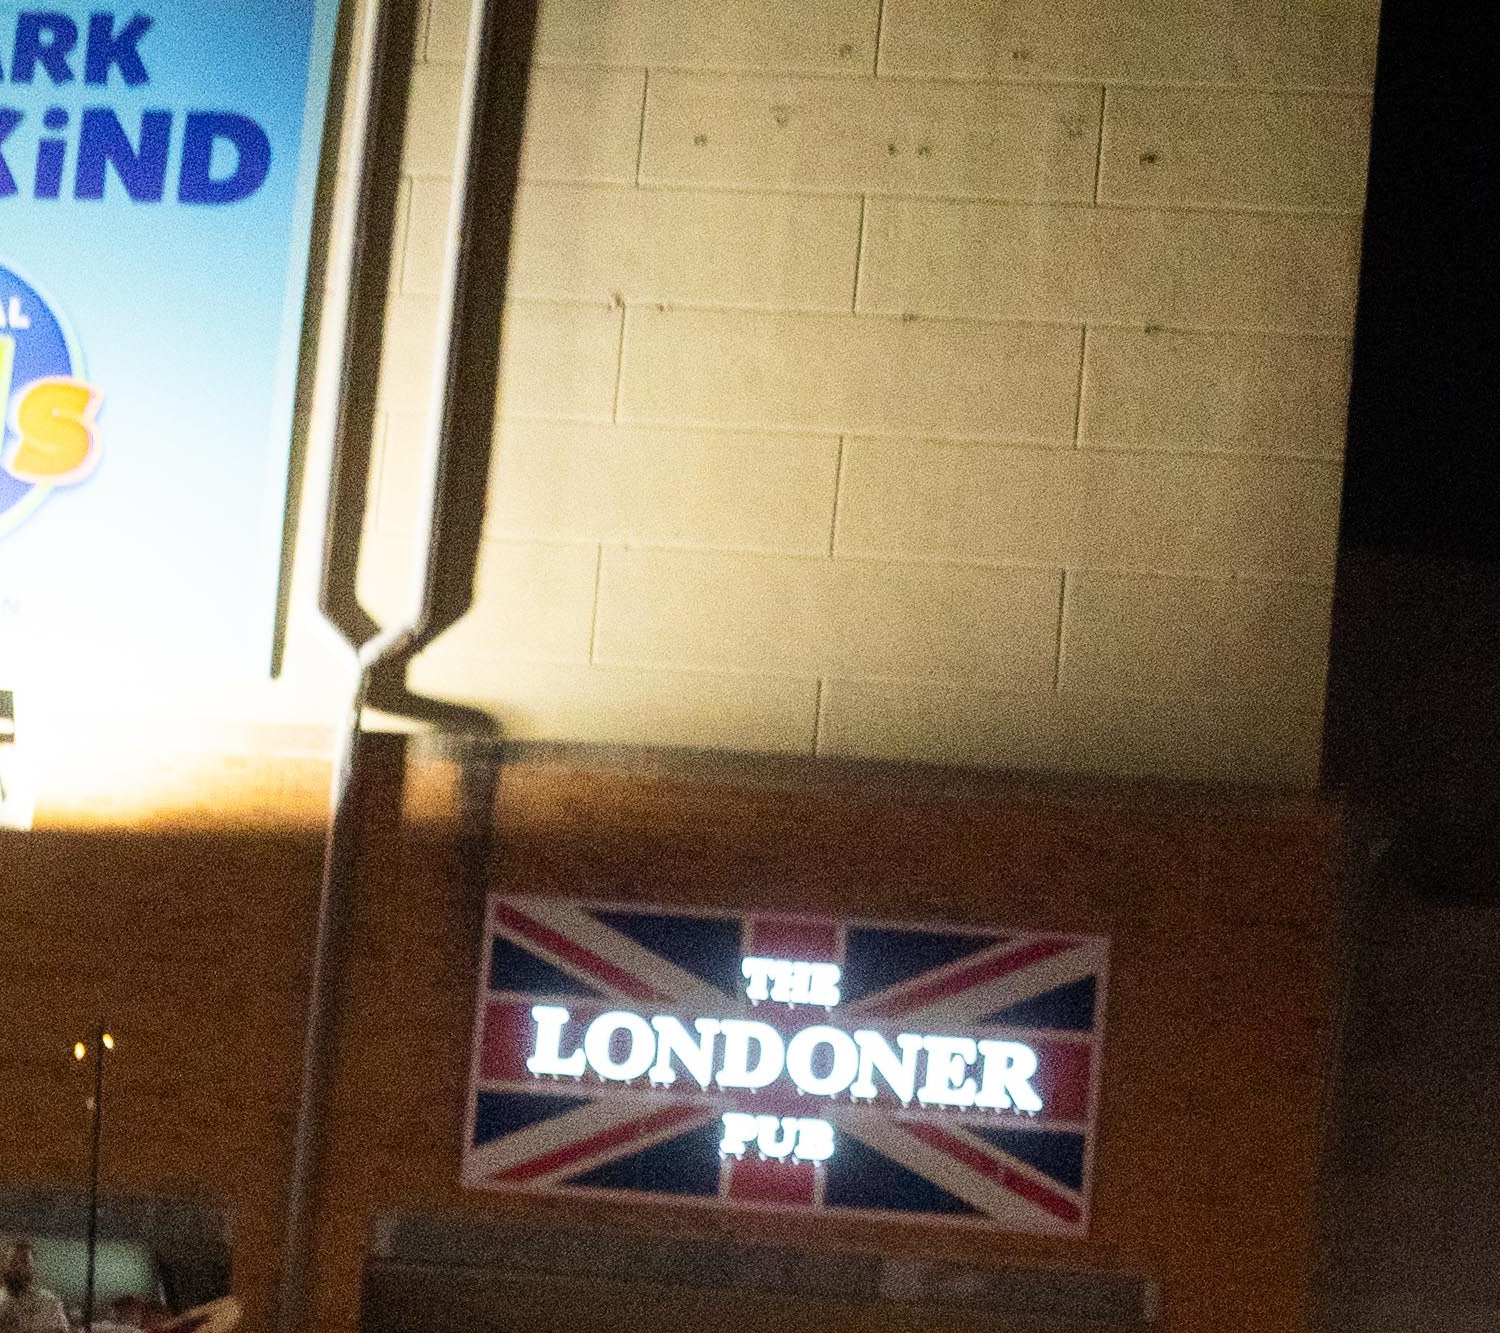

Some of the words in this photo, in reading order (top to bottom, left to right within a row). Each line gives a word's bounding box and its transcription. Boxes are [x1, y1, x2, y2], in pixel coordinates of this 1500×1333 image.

[741, 956, 842, 1006] THE
[527, 1005, 1043, 1112] LONDONER
[719, 1110, 836, 1162] PUB
